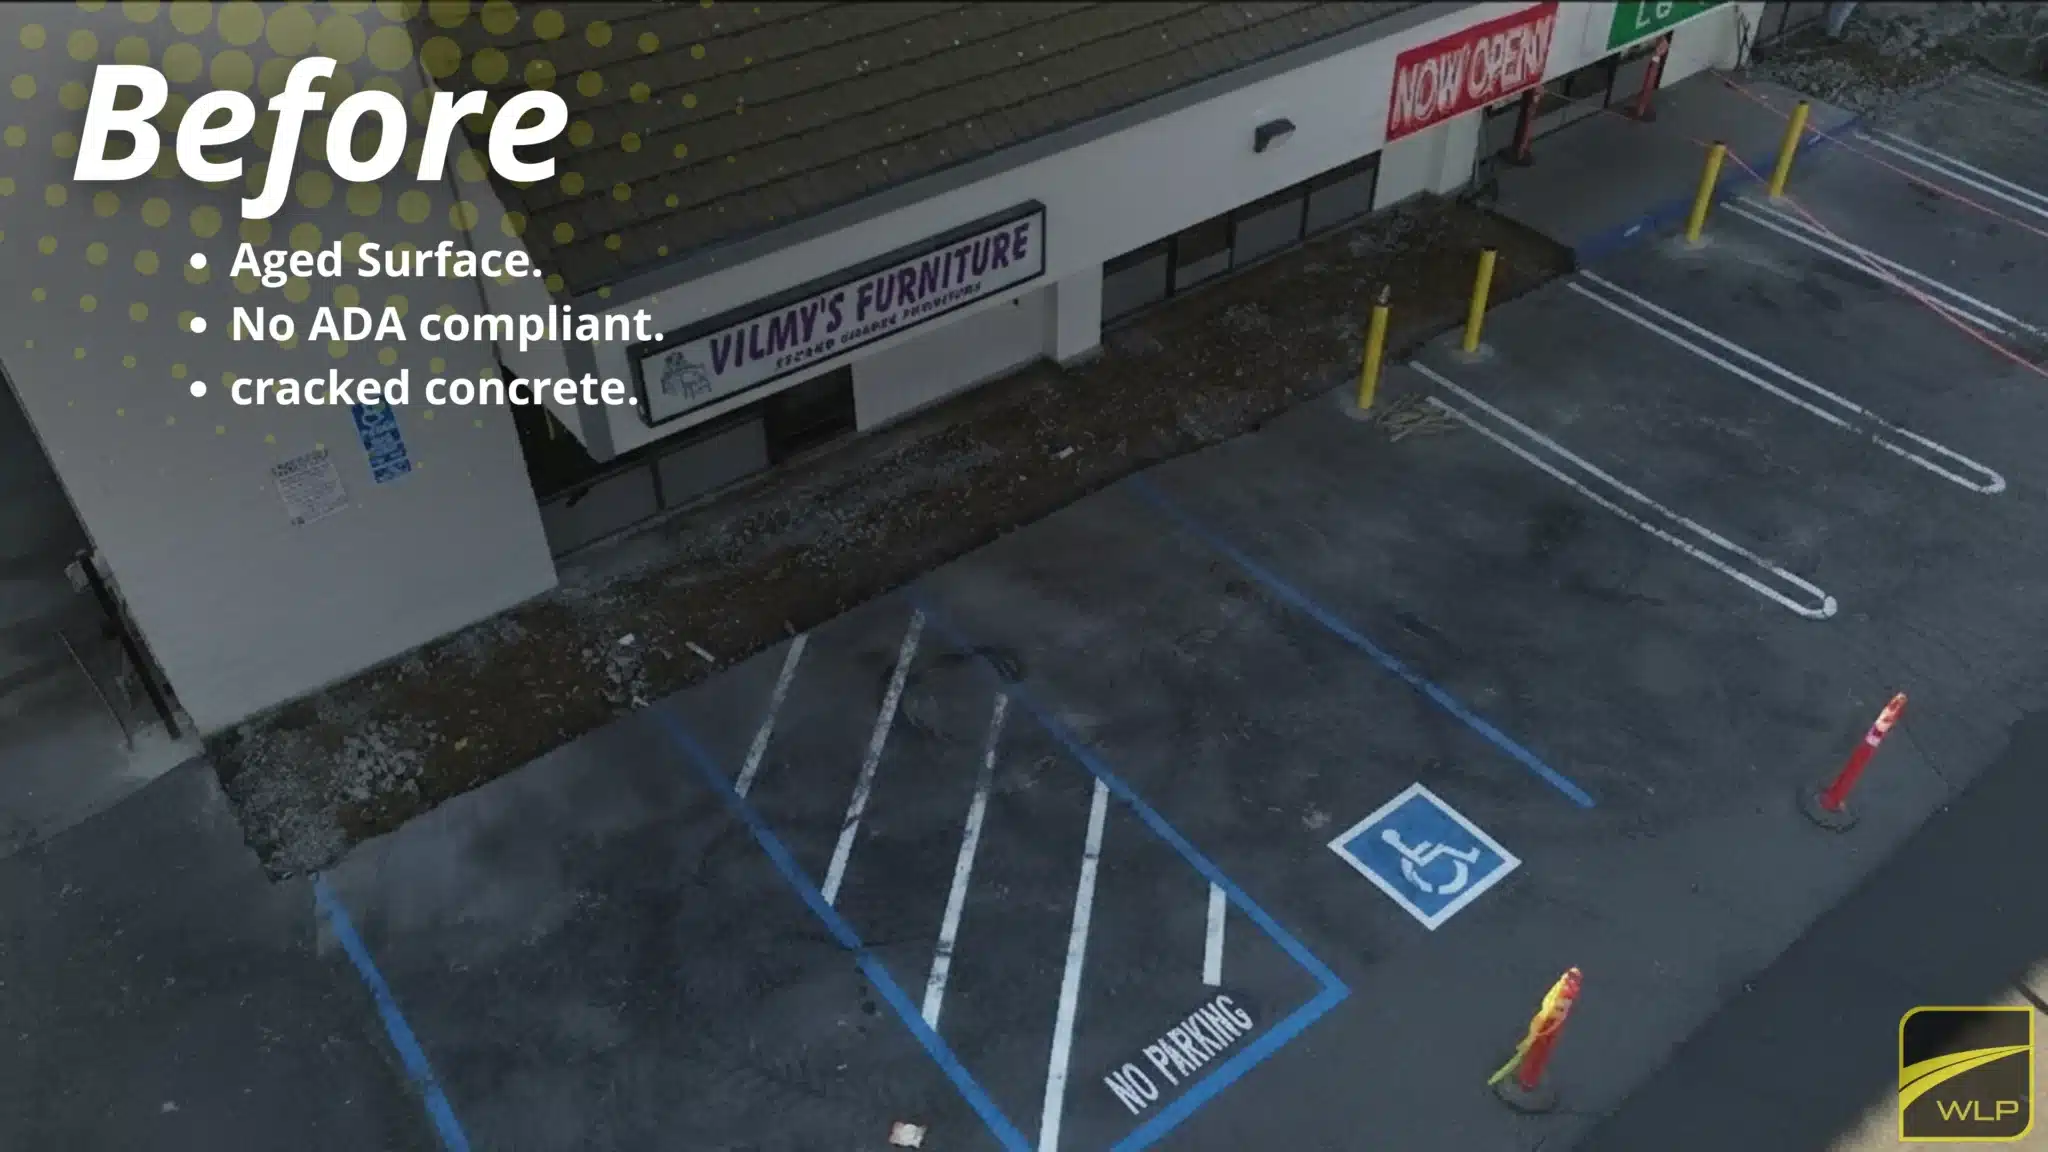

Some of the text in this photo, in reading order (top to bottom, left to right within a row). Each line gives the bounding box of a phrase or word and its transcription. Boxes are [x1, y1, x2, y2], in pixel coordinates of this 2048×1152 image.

[1391, 14, 1555, 131] NOW OPEN
[709, 291, 845, 376] VILMY'S
[856, 222, 1029, 322] FURNITURE
[1103, 994, 1254, 1116] NO PARKING
